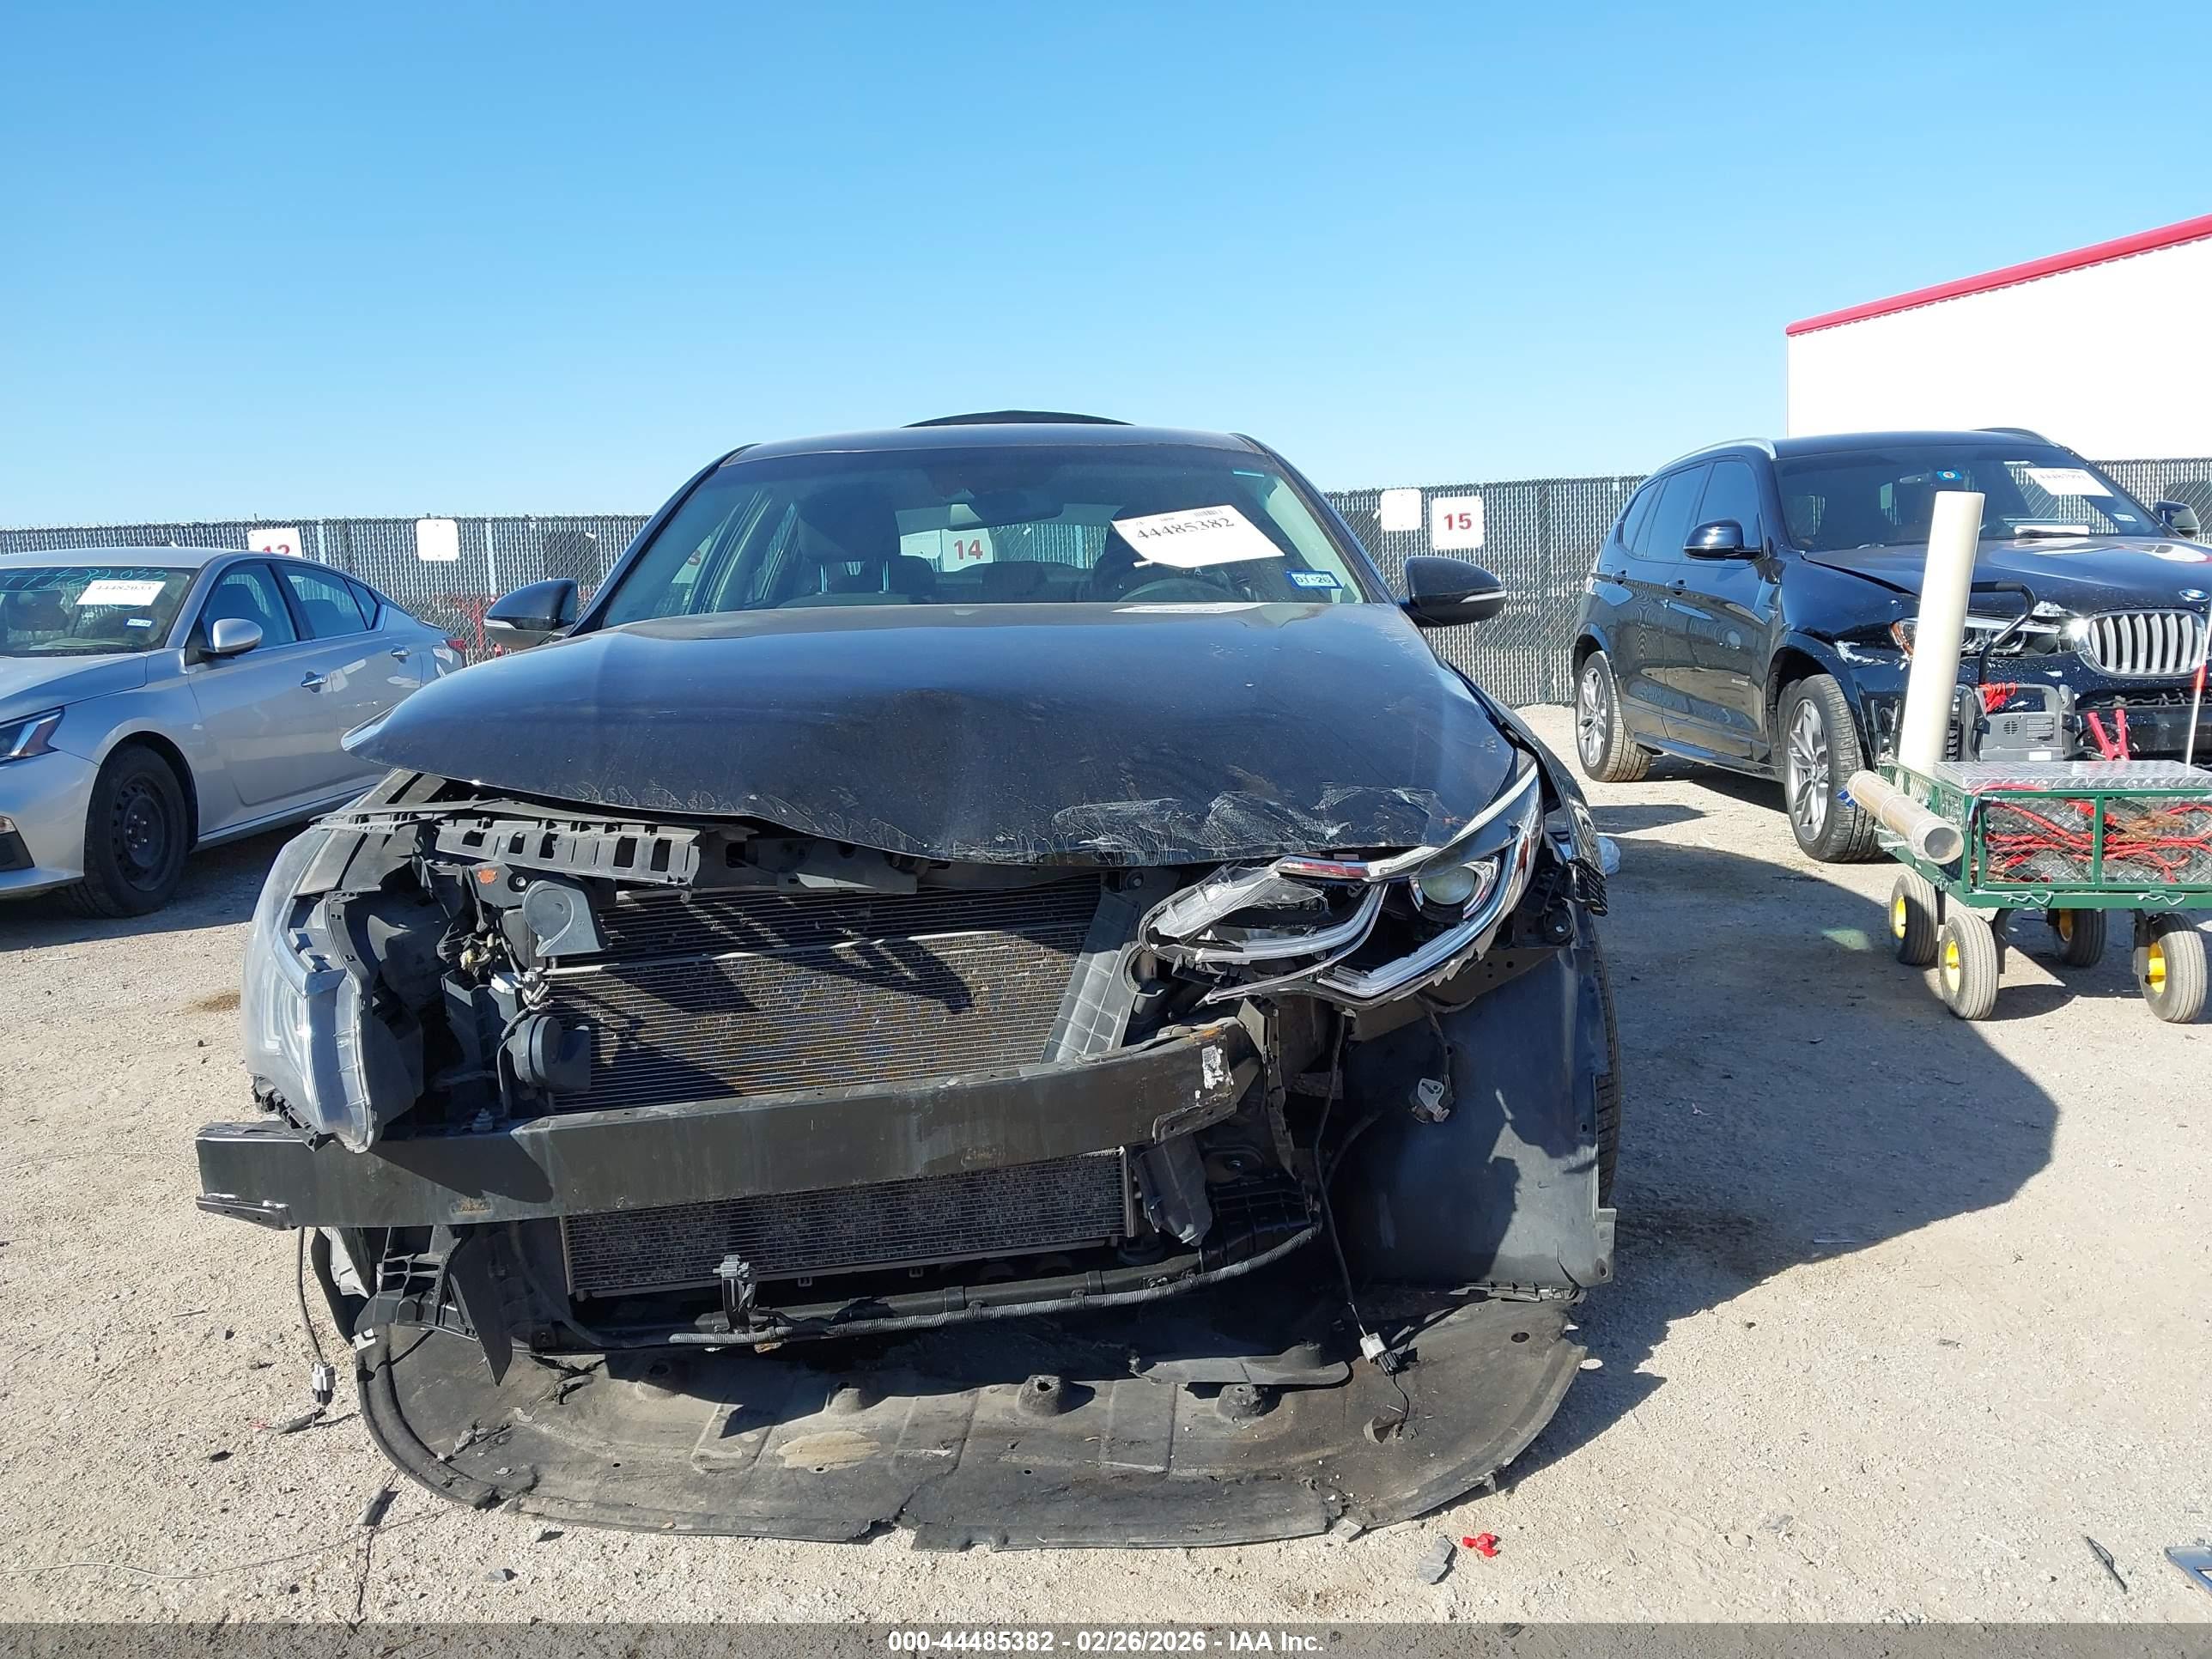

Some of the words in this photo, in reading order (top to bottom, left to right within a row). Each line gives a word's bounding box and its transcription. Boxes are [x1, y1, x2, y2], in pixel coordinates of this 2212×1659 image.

[1137, 517, 1235, 539] 44485382
[1443, 513, 1472, 531] 15
[953, 539, 983, 560] 14
